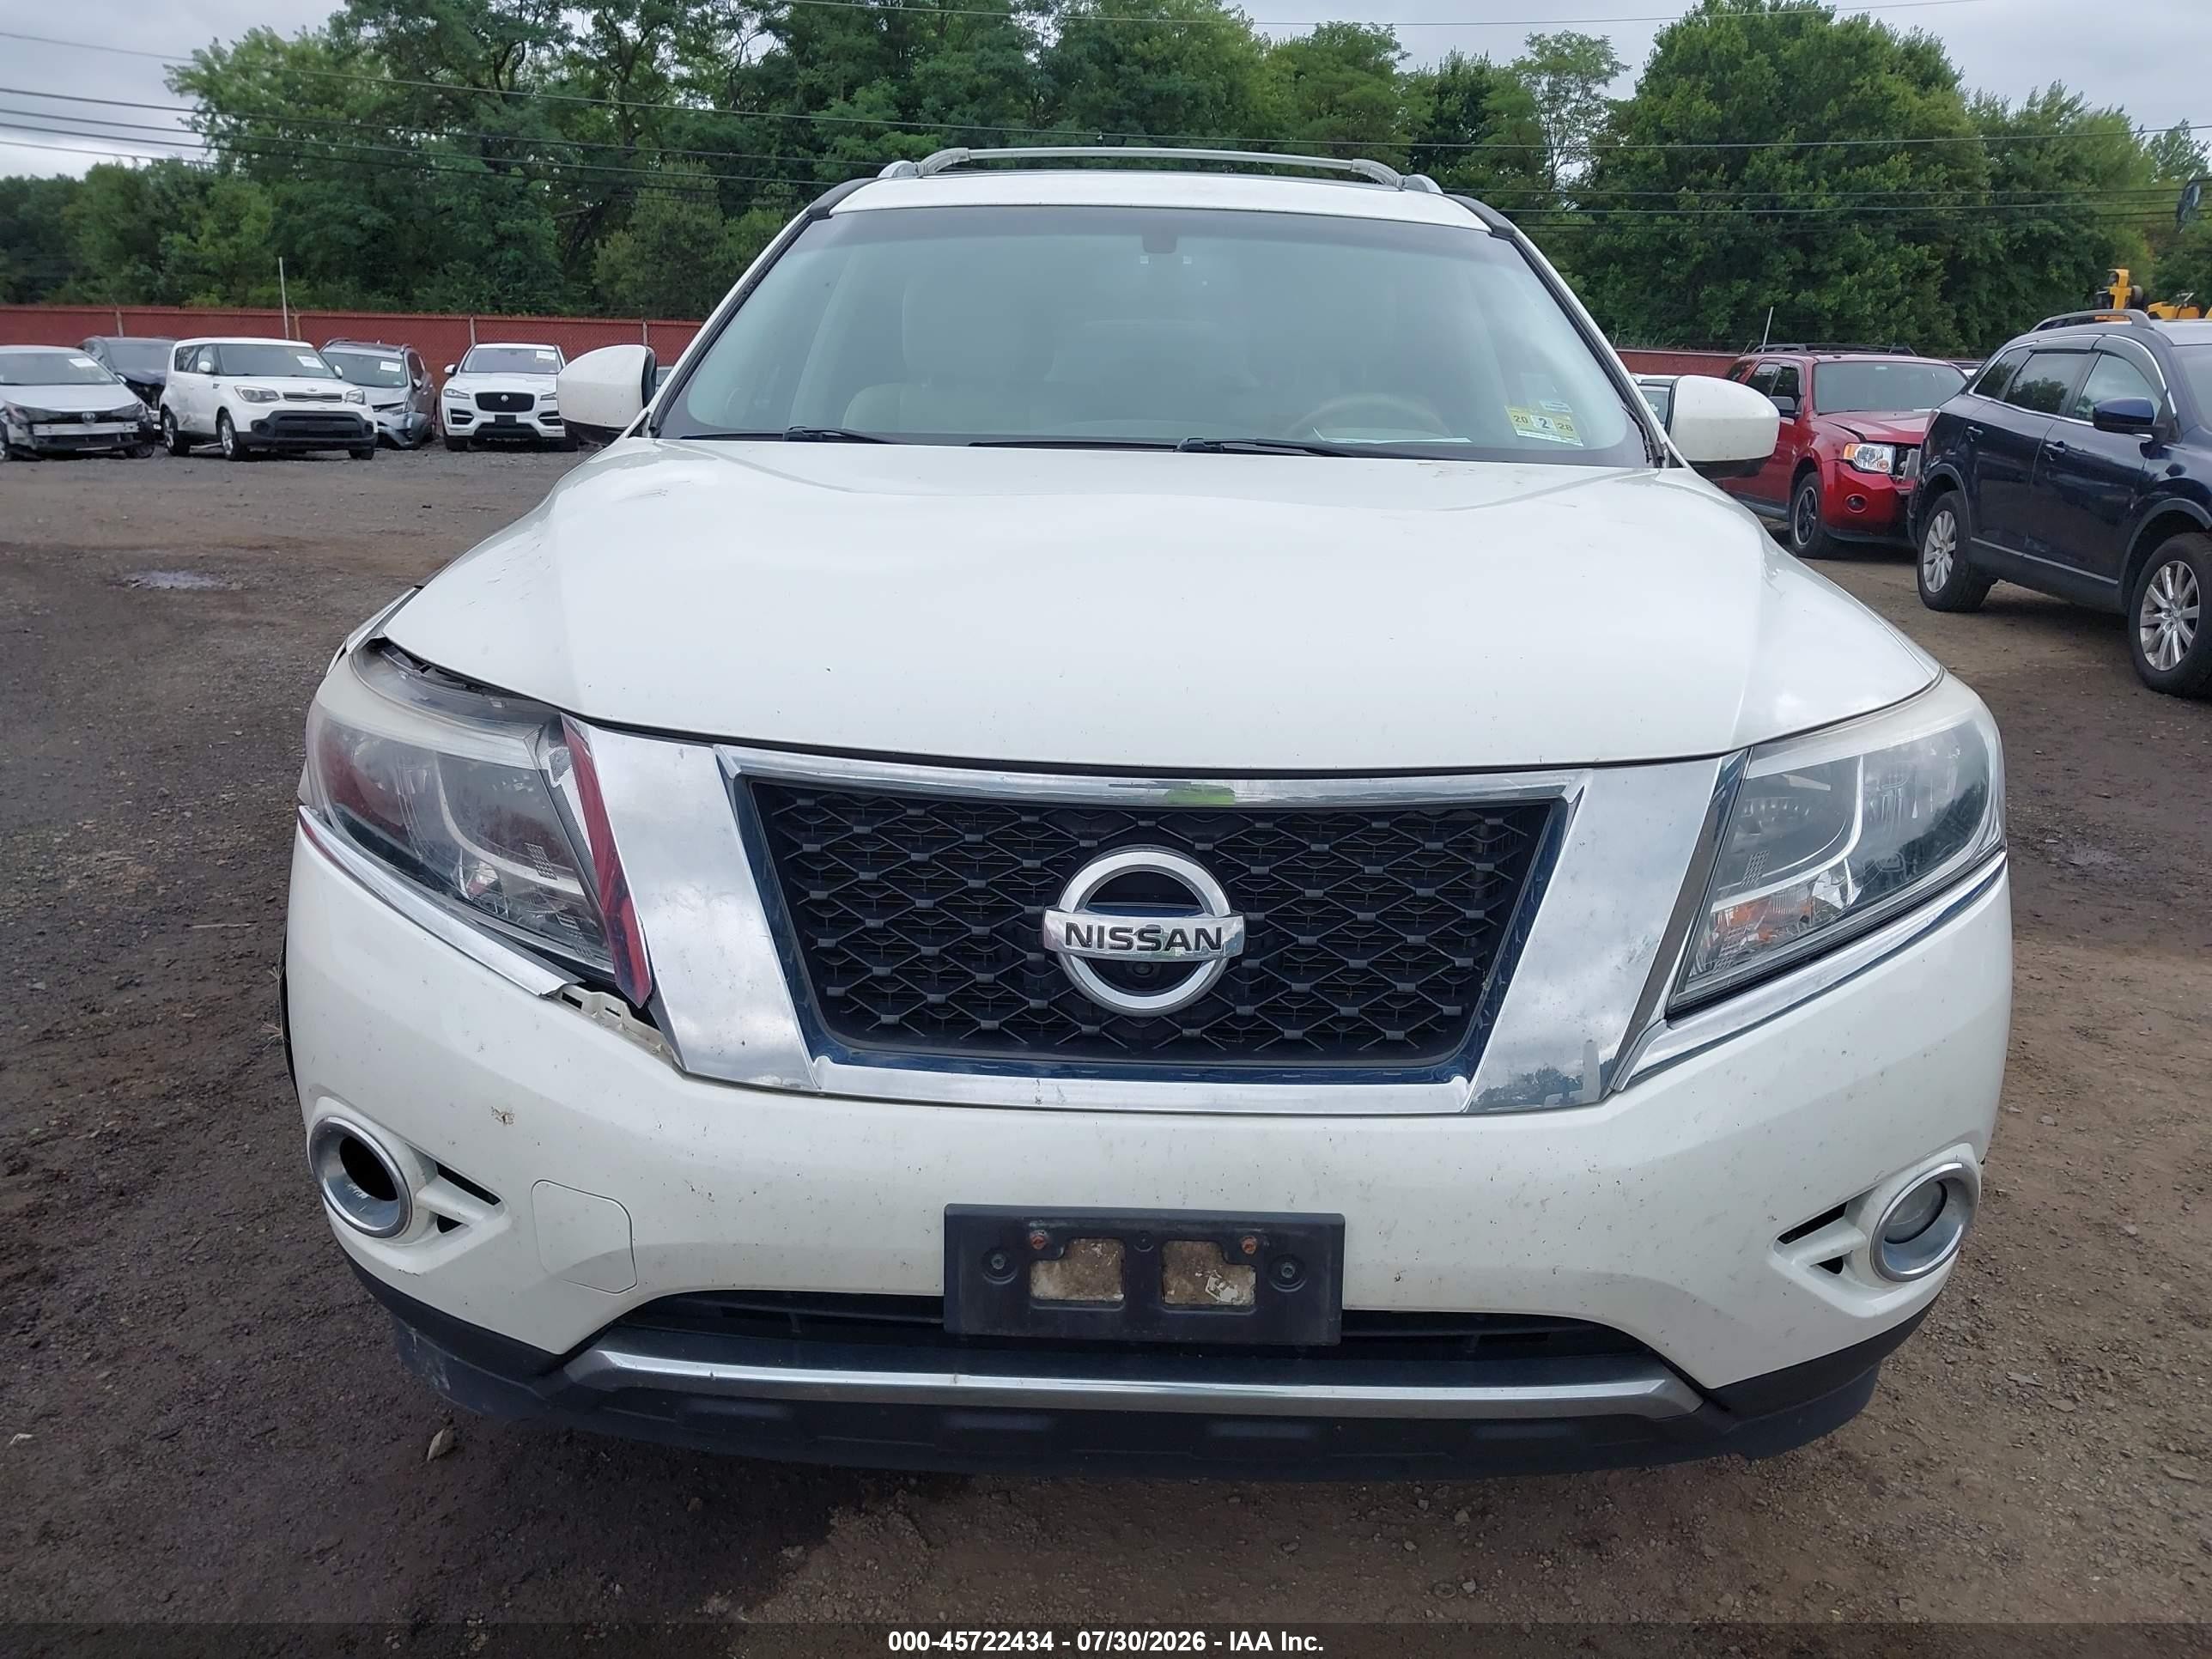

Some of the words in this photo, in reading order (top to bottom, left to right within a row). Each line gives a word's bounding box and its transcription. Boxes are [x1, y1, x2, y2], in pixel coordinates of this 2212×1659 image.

[1513, 415, 1529, 424] 20
[1538, 417, 1550, 429] 2
[1065, 921, 1223, 952] NISSAN
